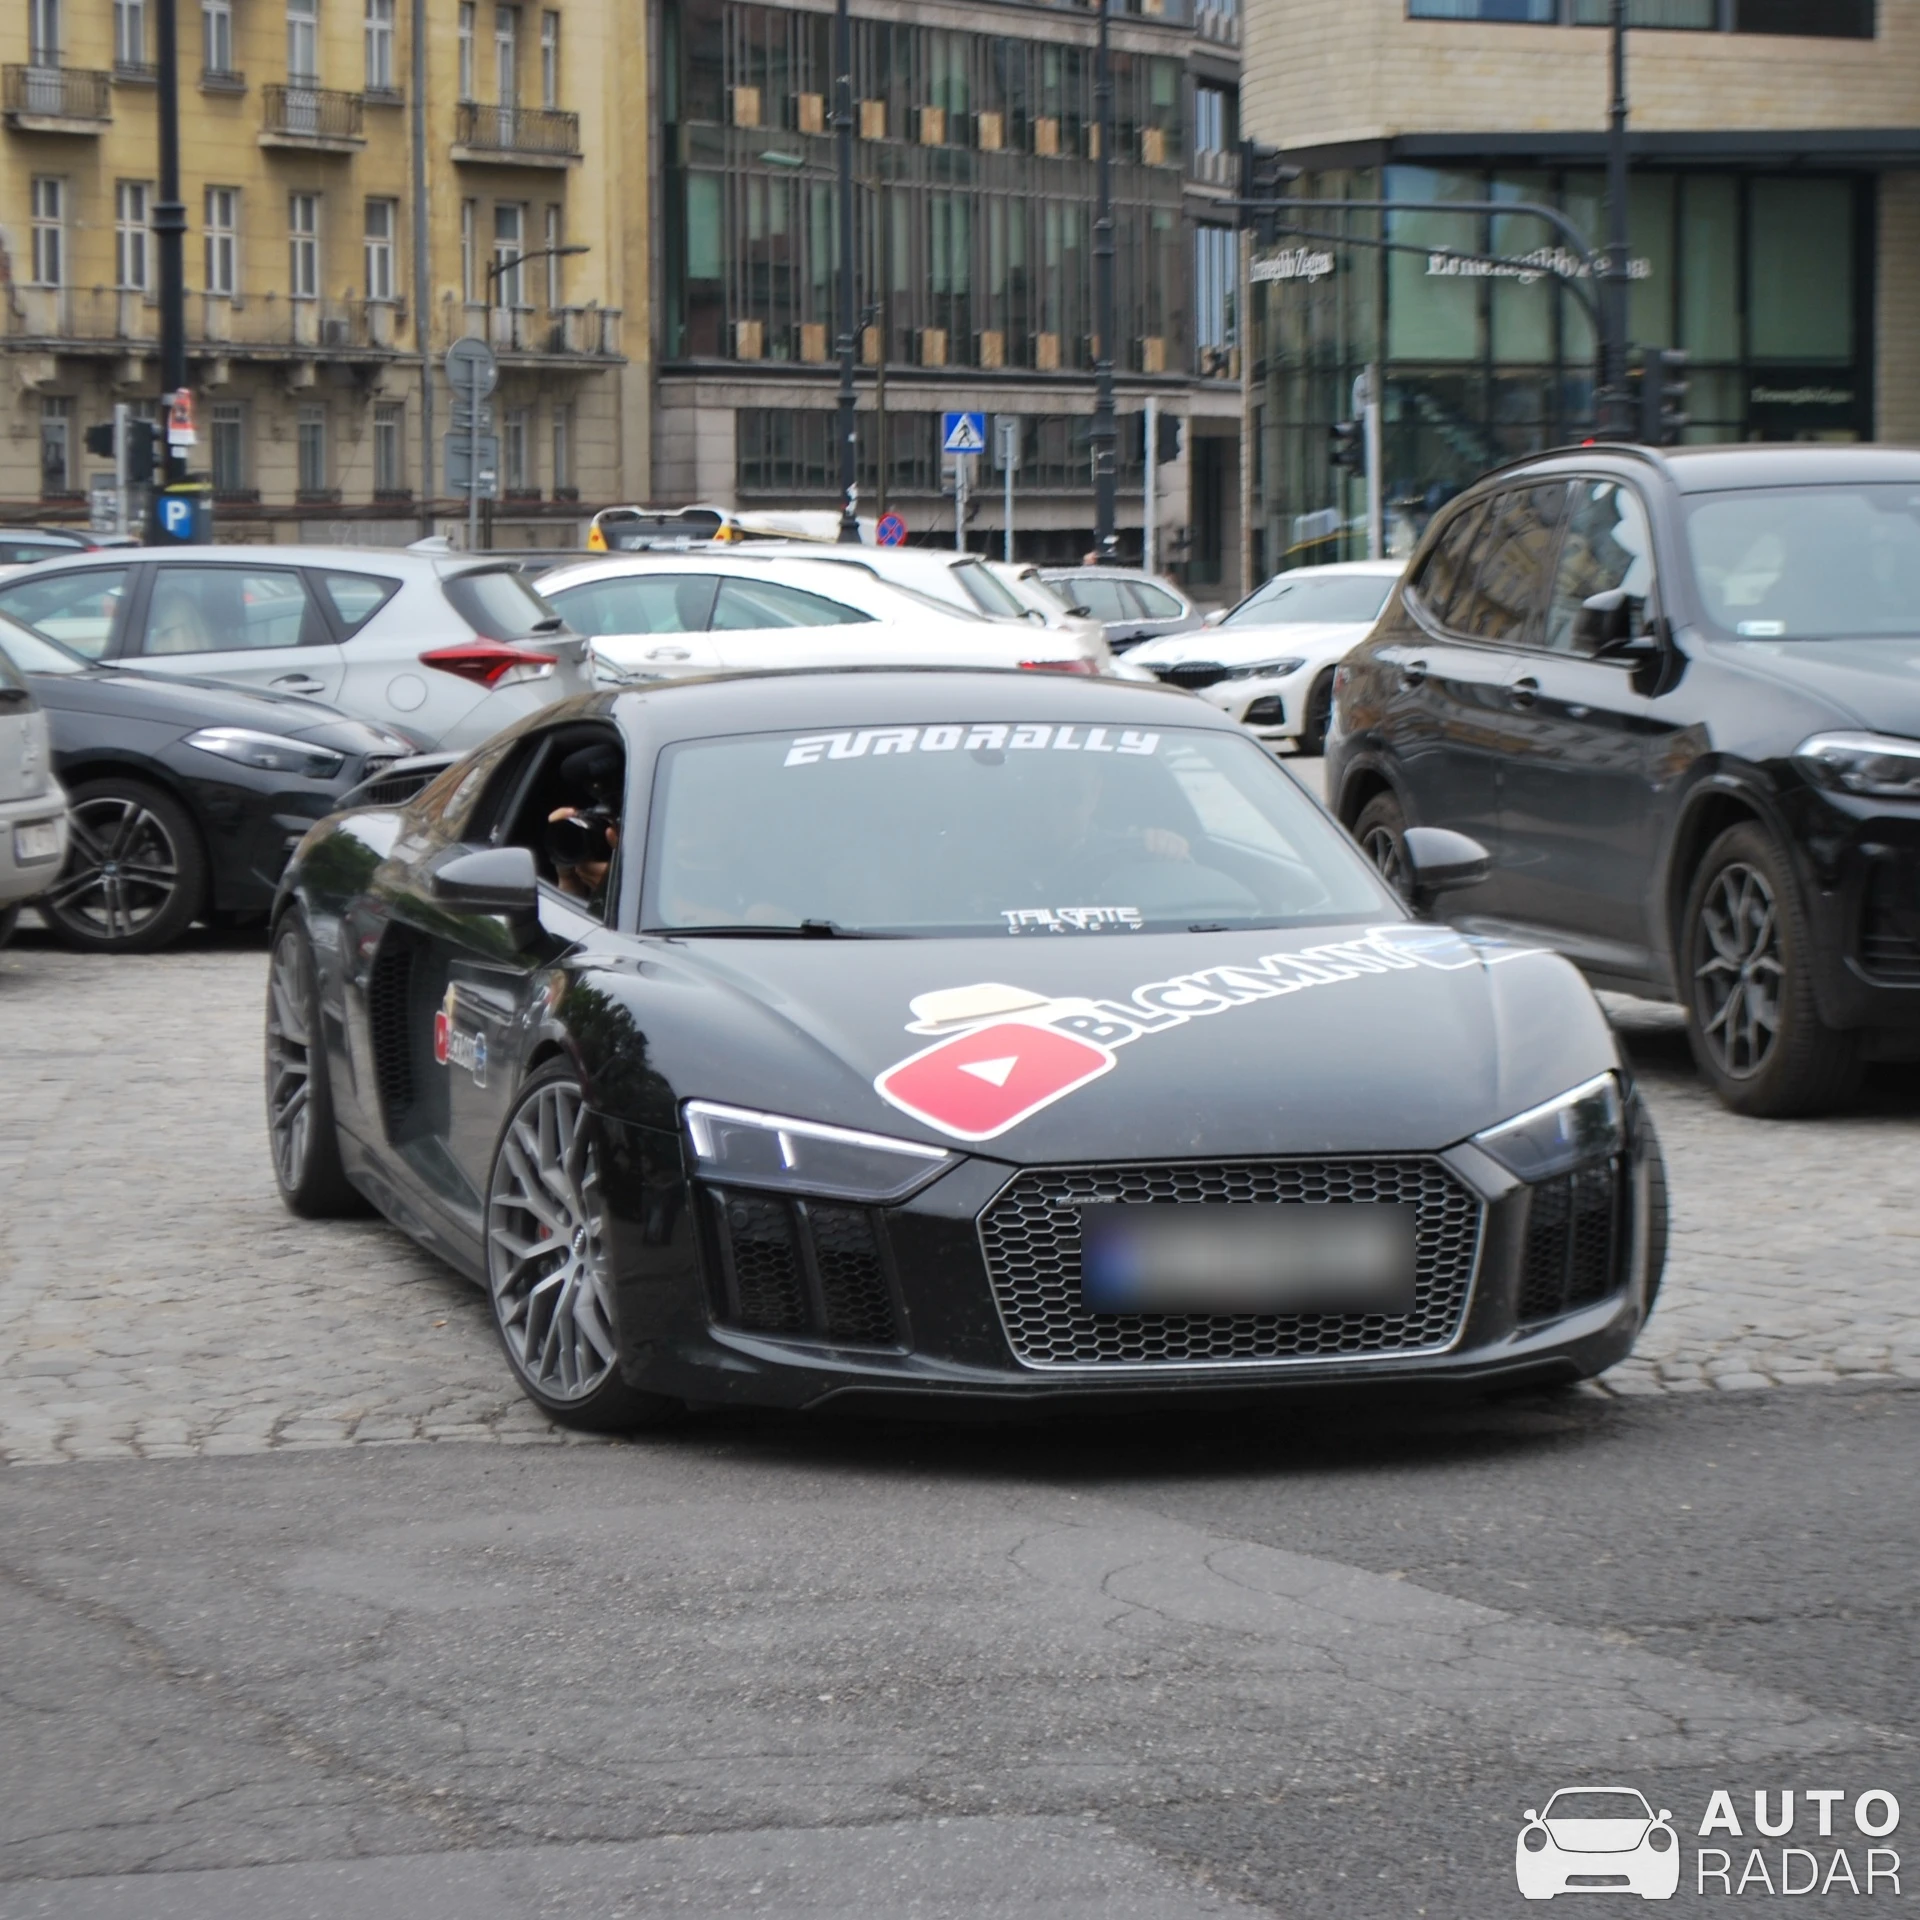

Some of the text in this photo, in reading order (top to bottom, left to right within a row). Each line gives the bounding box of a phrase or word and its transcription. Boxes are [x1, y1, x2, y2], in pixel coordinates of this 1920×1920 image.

[167, 501, 187, 531] P
[784, 724, 1160, 767] EURORALLY
[1001, 906, 1143, 930] TAILGATE
